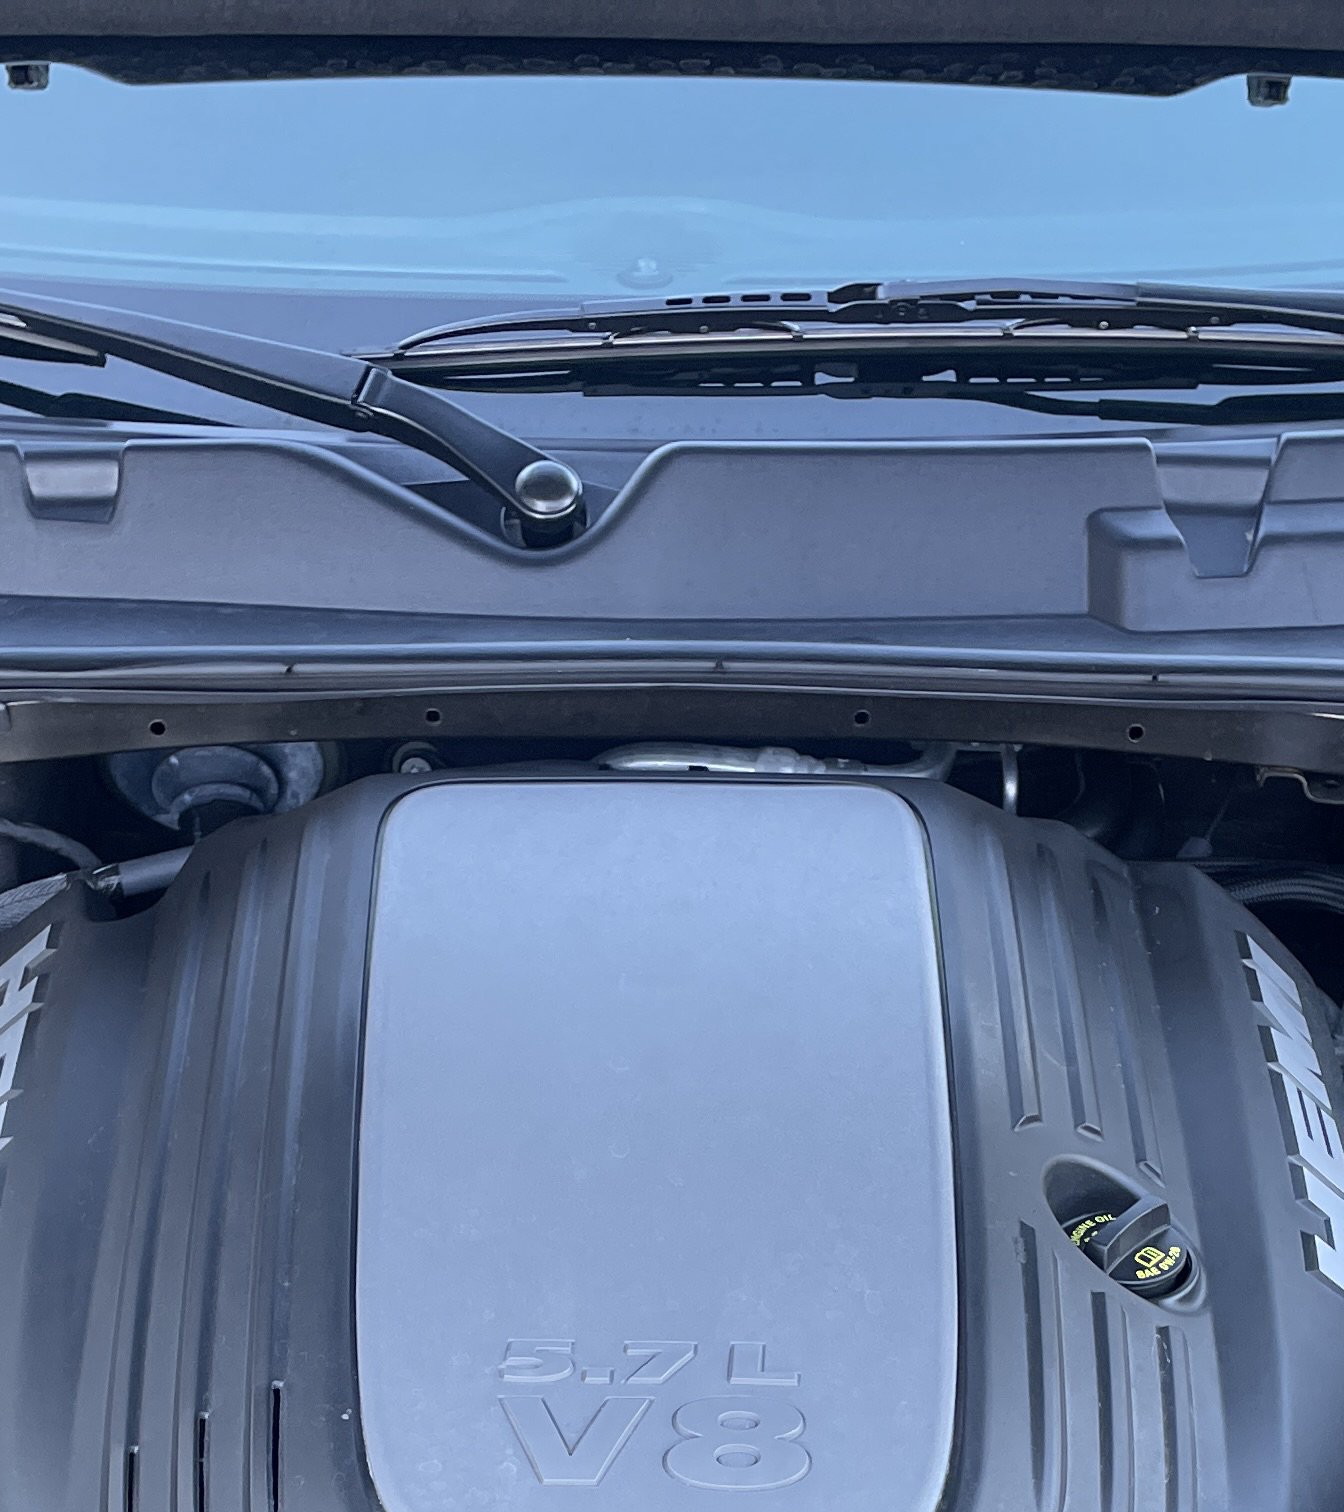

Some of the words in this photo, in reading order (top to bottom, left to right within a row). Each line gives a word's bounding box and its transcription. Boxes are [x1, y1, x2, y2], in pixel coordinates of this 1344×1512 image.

[1094, 1214, 1117, 1223] OIL
[1136, 1267, 1161, 1279] SAE
[497, 1394, 813, 1492] V8
